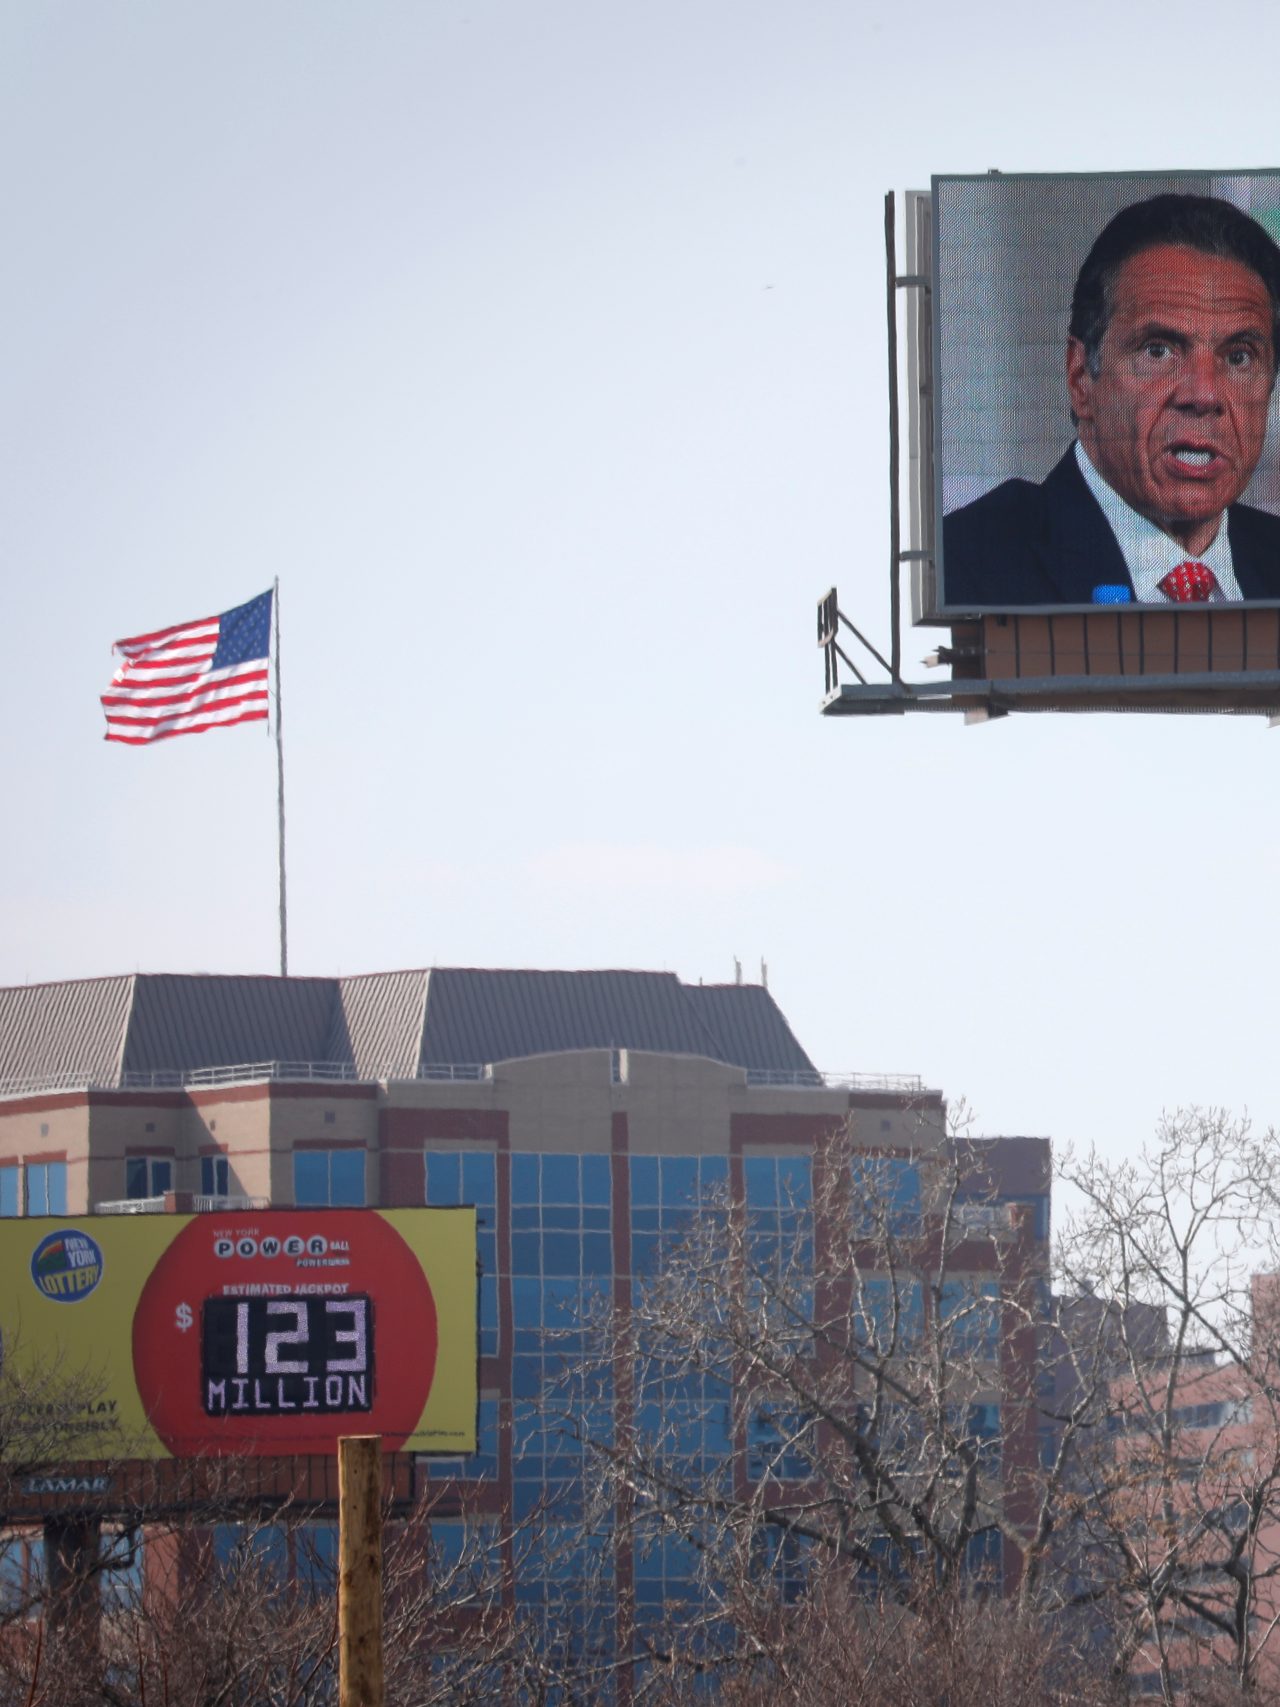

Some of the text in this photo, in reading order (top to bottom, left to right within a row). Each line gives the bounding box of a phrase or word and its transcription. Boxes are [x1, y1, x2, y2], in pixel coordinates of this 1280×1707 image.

[213, 1228, 259, 1238] NEW YORK
[64, 1237, 89, 1252] NEW
[215, 1237, 326, 1257] POWER
[67, 1248, 97, 1268] YORK
[39, 1264, 99, 1295] LOTTERY
[223, 1282, 349, 1296] ESTIMATED JACKPOT
[175, 1299, 366, 1375] $ 123
[208, 1374, 367, 1411] MILLION
[28, 1477, 107, 1493] LAMAR
